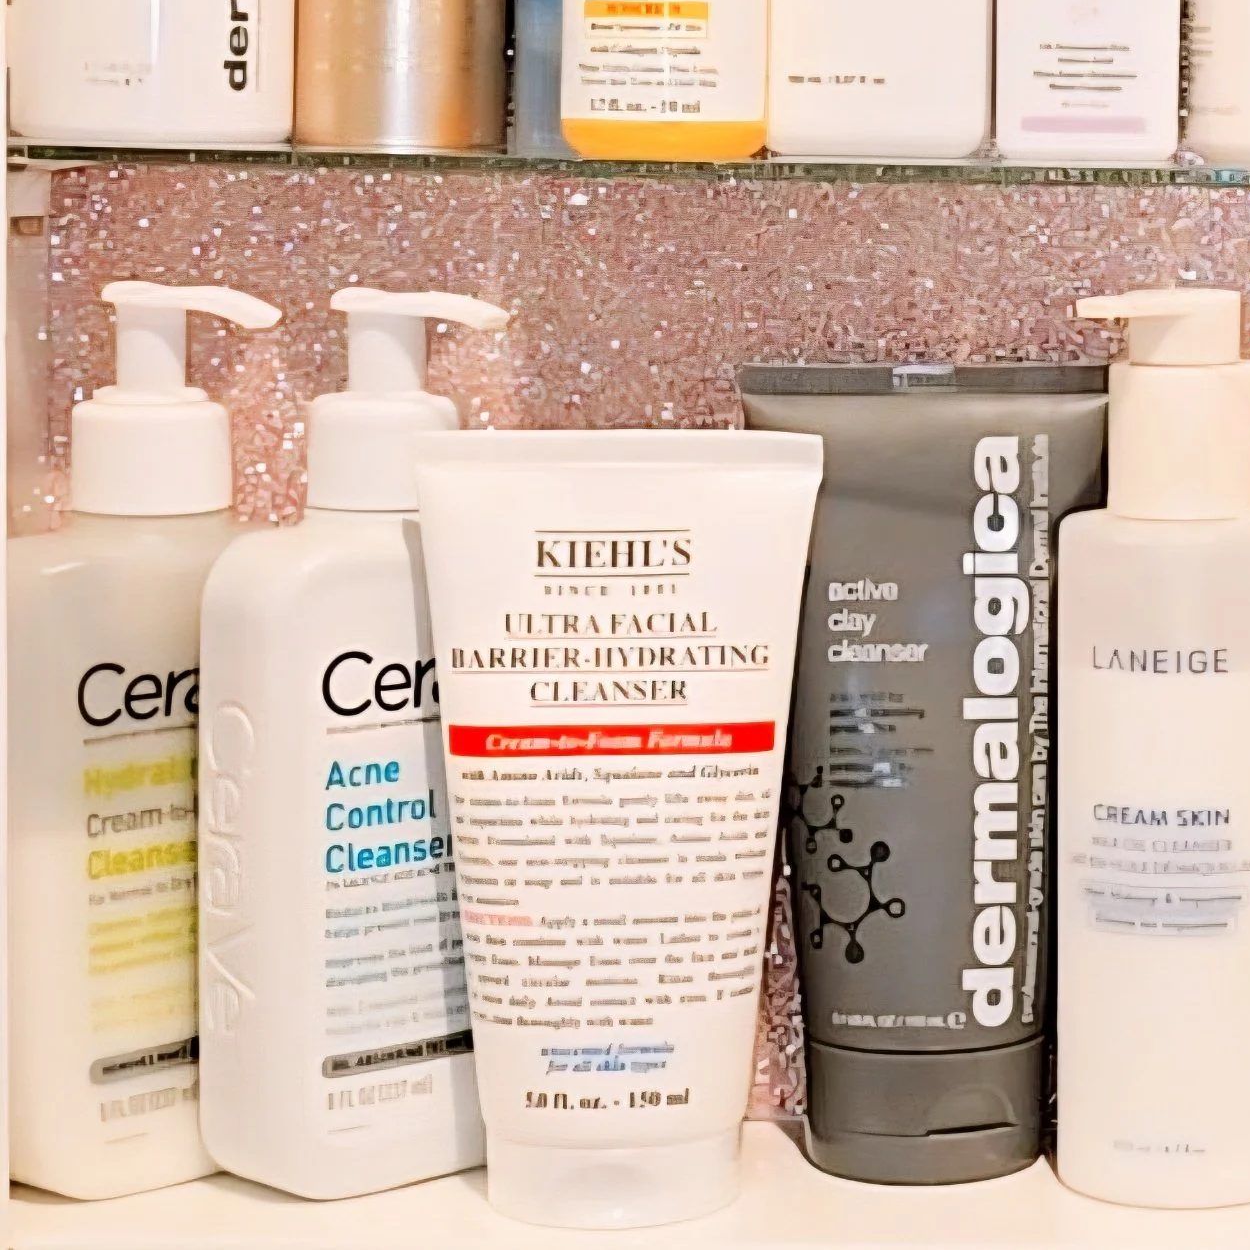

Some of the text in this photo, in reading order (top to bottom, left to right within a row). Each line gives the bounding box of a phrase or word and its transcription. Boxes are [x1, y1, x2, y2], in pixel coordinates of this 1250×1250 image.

[536, 538, 691, 568] KIEHL'S
[505, 612, 718, 635] ULTRA FACIAL
[828, 608, 876, 637] clay
[452, 644, 769, 669] BARRIER-HYDRATING
[1093, 646, 1229, 674] LANEIGE
[322, 650, 440, 717] Cer
[530, 680, 688, 702] CLEANSER
[962, 435, 1030, 1028] dermalogica
[325, 760, 400, 791] Acne
[325, 788, 437, 832] Control
[1093, 804, 1231, 826] CREAM SKIN
